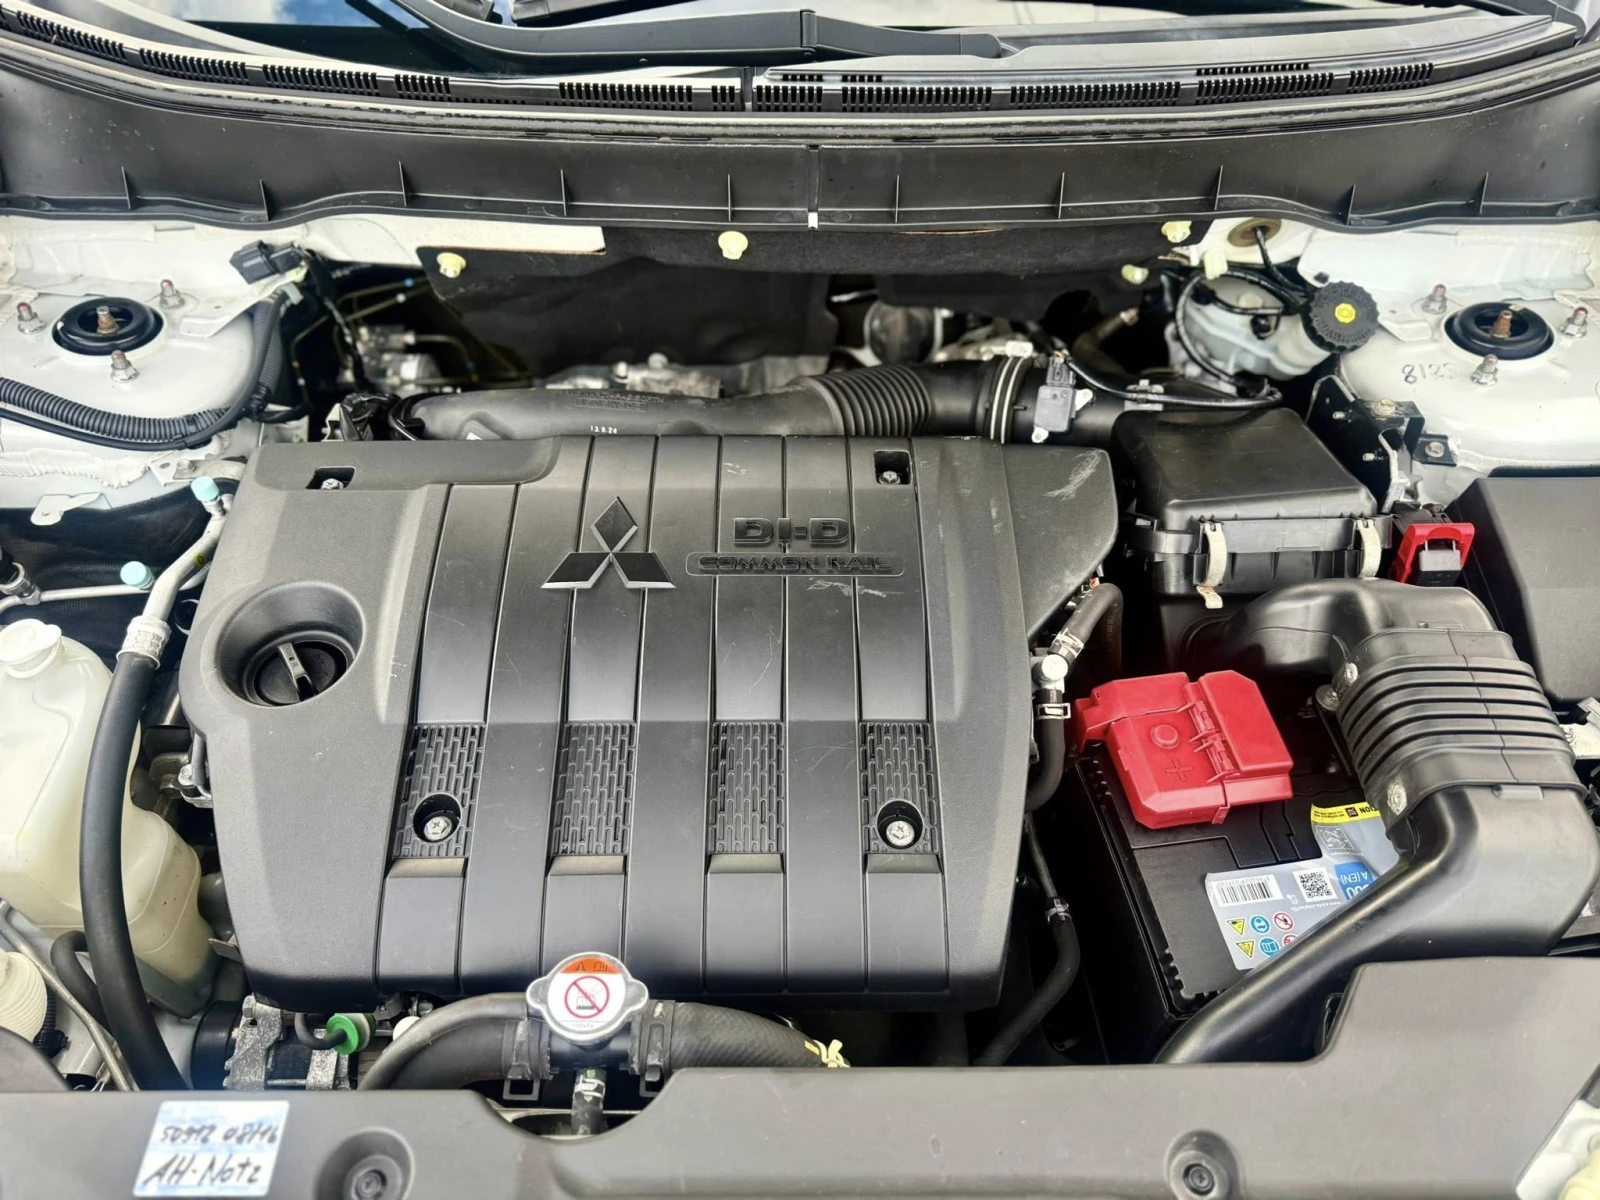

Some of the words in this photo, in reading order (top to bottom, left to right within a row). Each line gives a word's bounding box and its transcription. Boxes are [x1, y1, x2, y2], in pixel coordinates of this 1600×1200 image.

[733, 517, 849, 547] DI-D
[699, 555, 819, 573] COMMON
[826, 555, 893, 573] RAIL
[1340, 873, 1361, 885] (EN)
